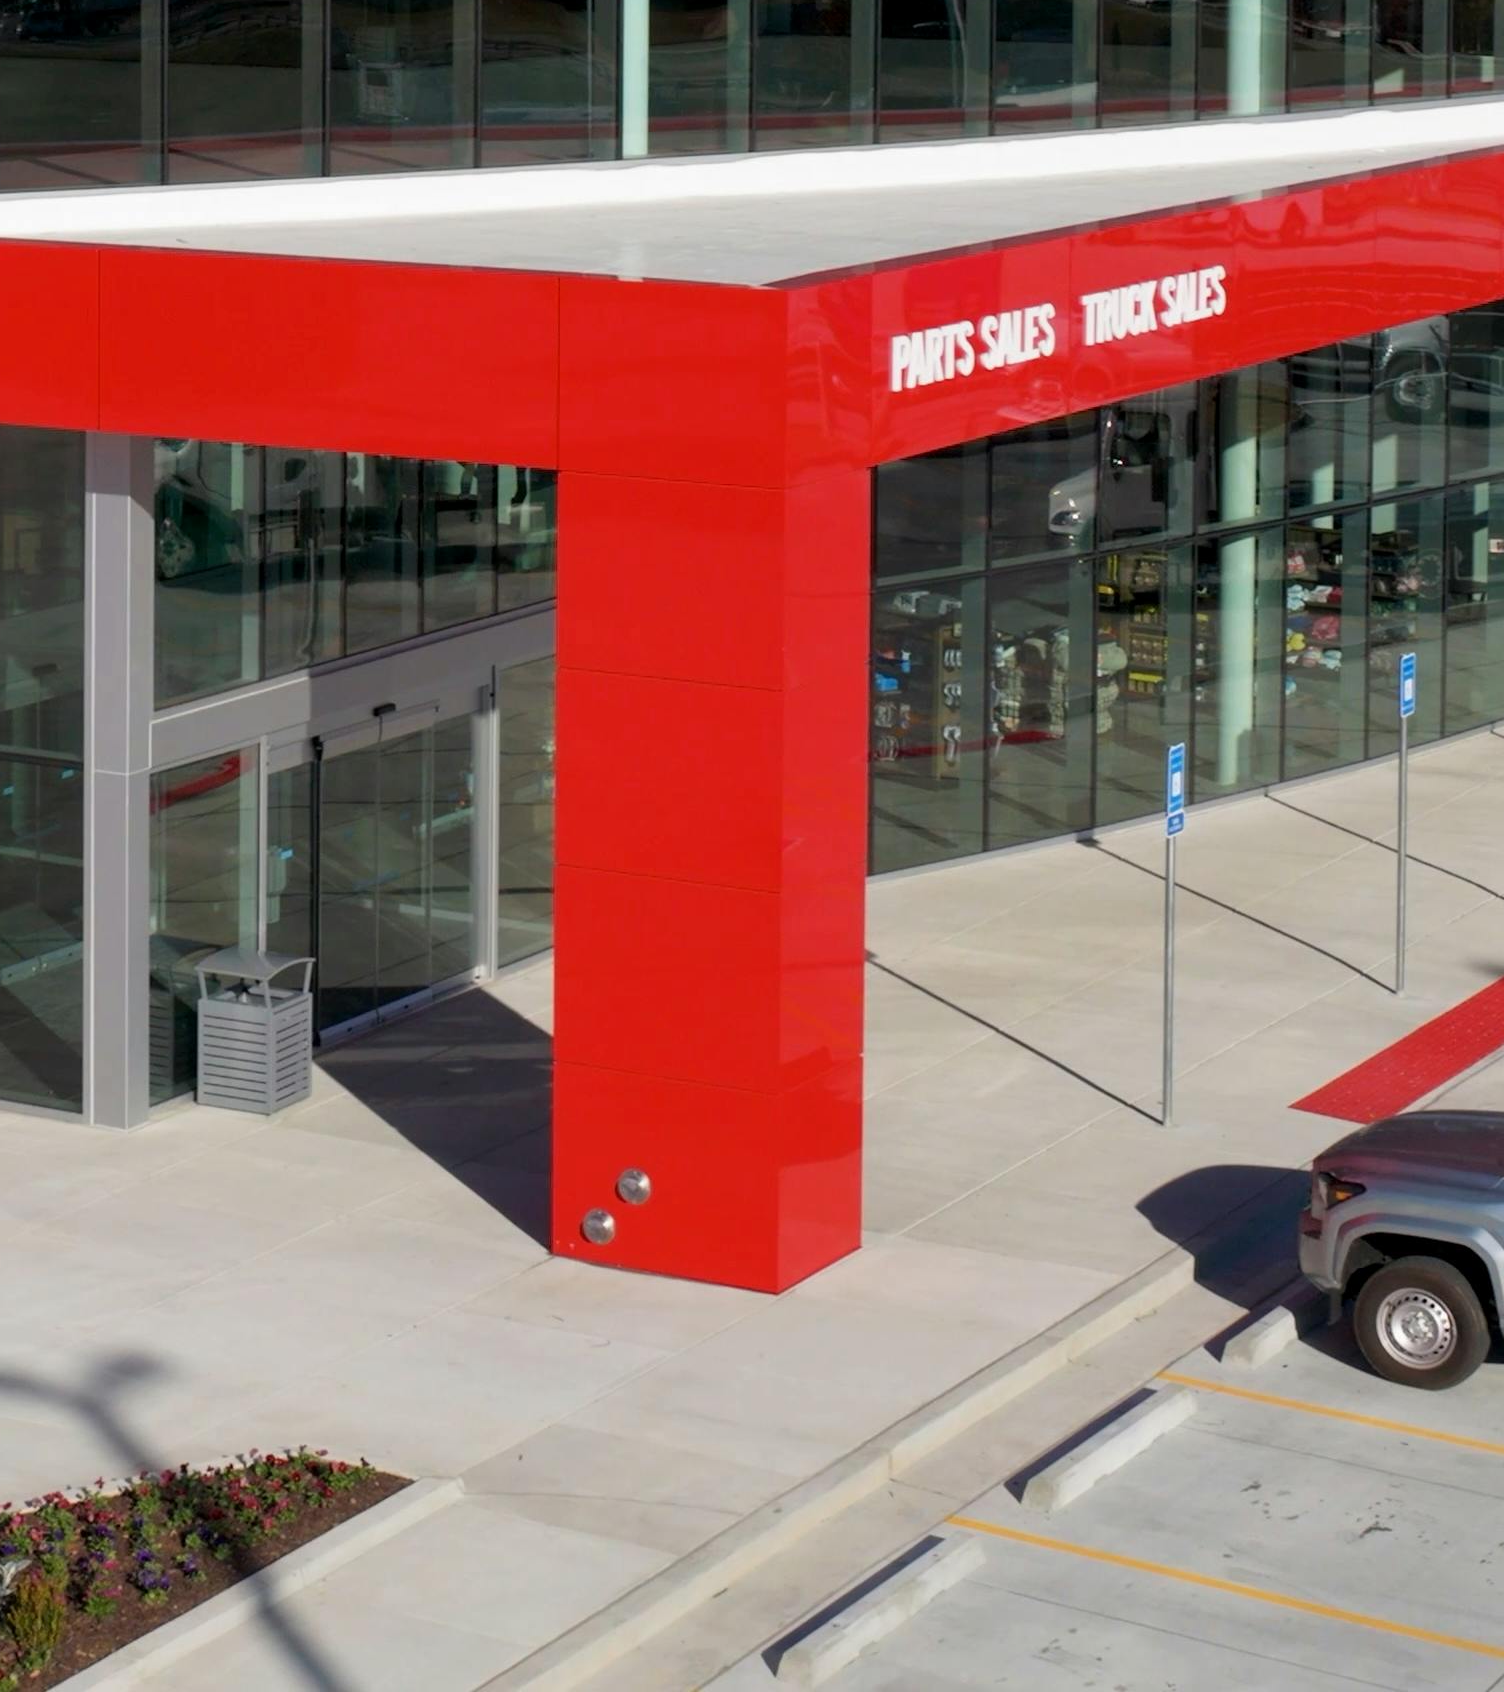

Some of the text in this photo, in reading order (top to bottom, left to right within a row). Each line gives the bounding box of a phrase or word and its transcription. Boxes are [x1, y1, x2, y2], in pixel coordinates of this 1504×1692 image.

[890, 265, 1227, 393] PARTS SALES TRUCK SALES
